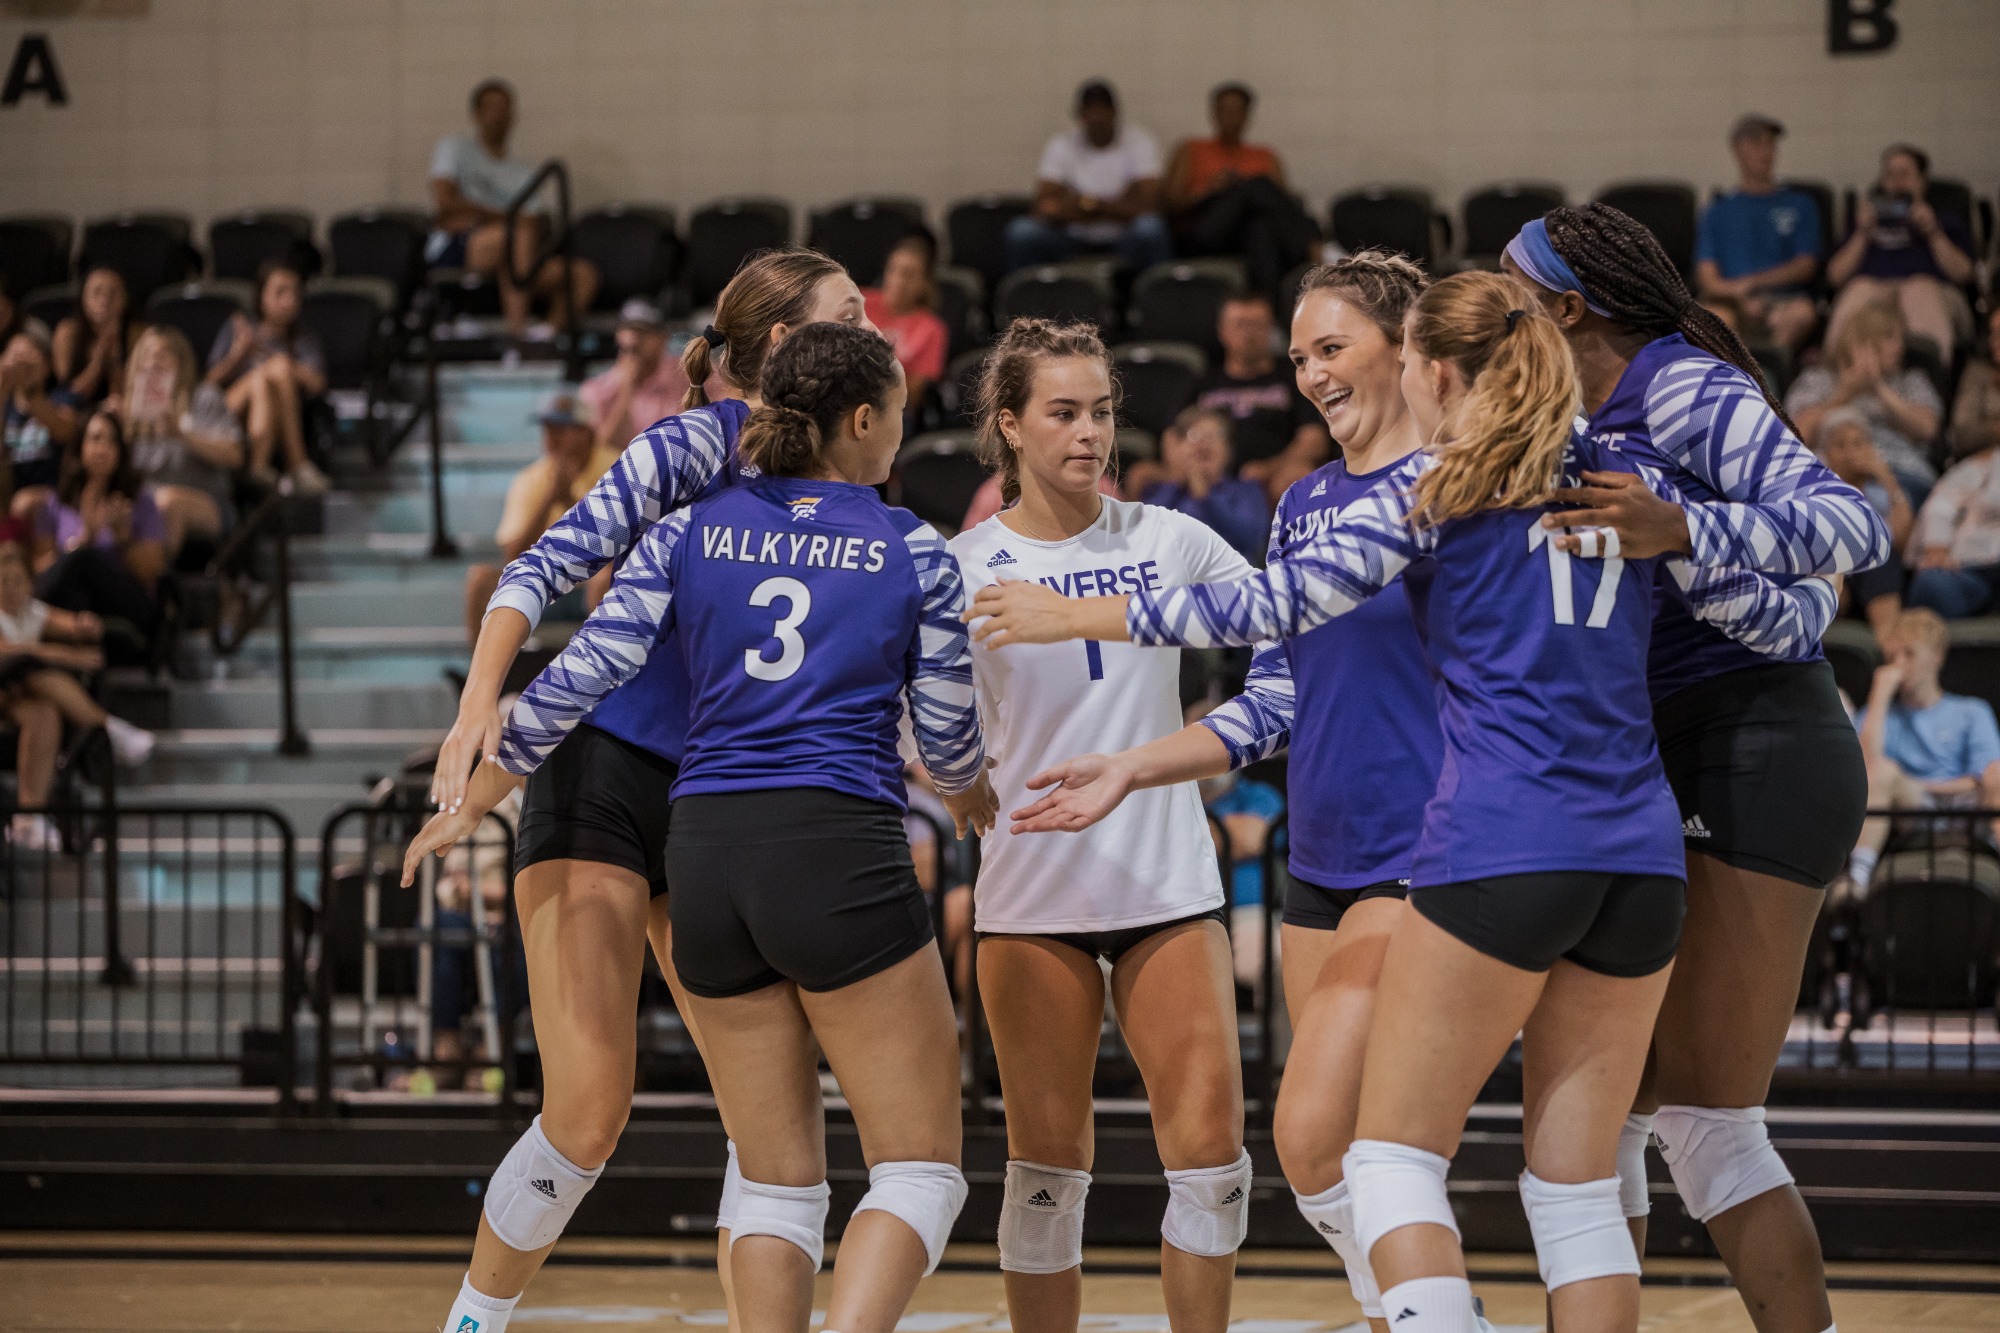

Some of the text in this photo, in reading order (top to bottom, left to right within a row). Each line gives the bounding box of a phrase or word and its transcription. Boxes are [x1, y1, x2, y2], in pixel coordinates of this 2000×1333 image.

[1828, 0, 1898, 54] B
[2, 34, 67, 106] A
[703, 525, 888, 573] VALKYRIES
[987, 558, 1018, 568] adidas
[744, 576, 812, 682] 3
[1682, 829, 1711, 838] didas
[531, 1180, 558, 1199] adidas
[1027, 1199, 1057, 1207] adidas
